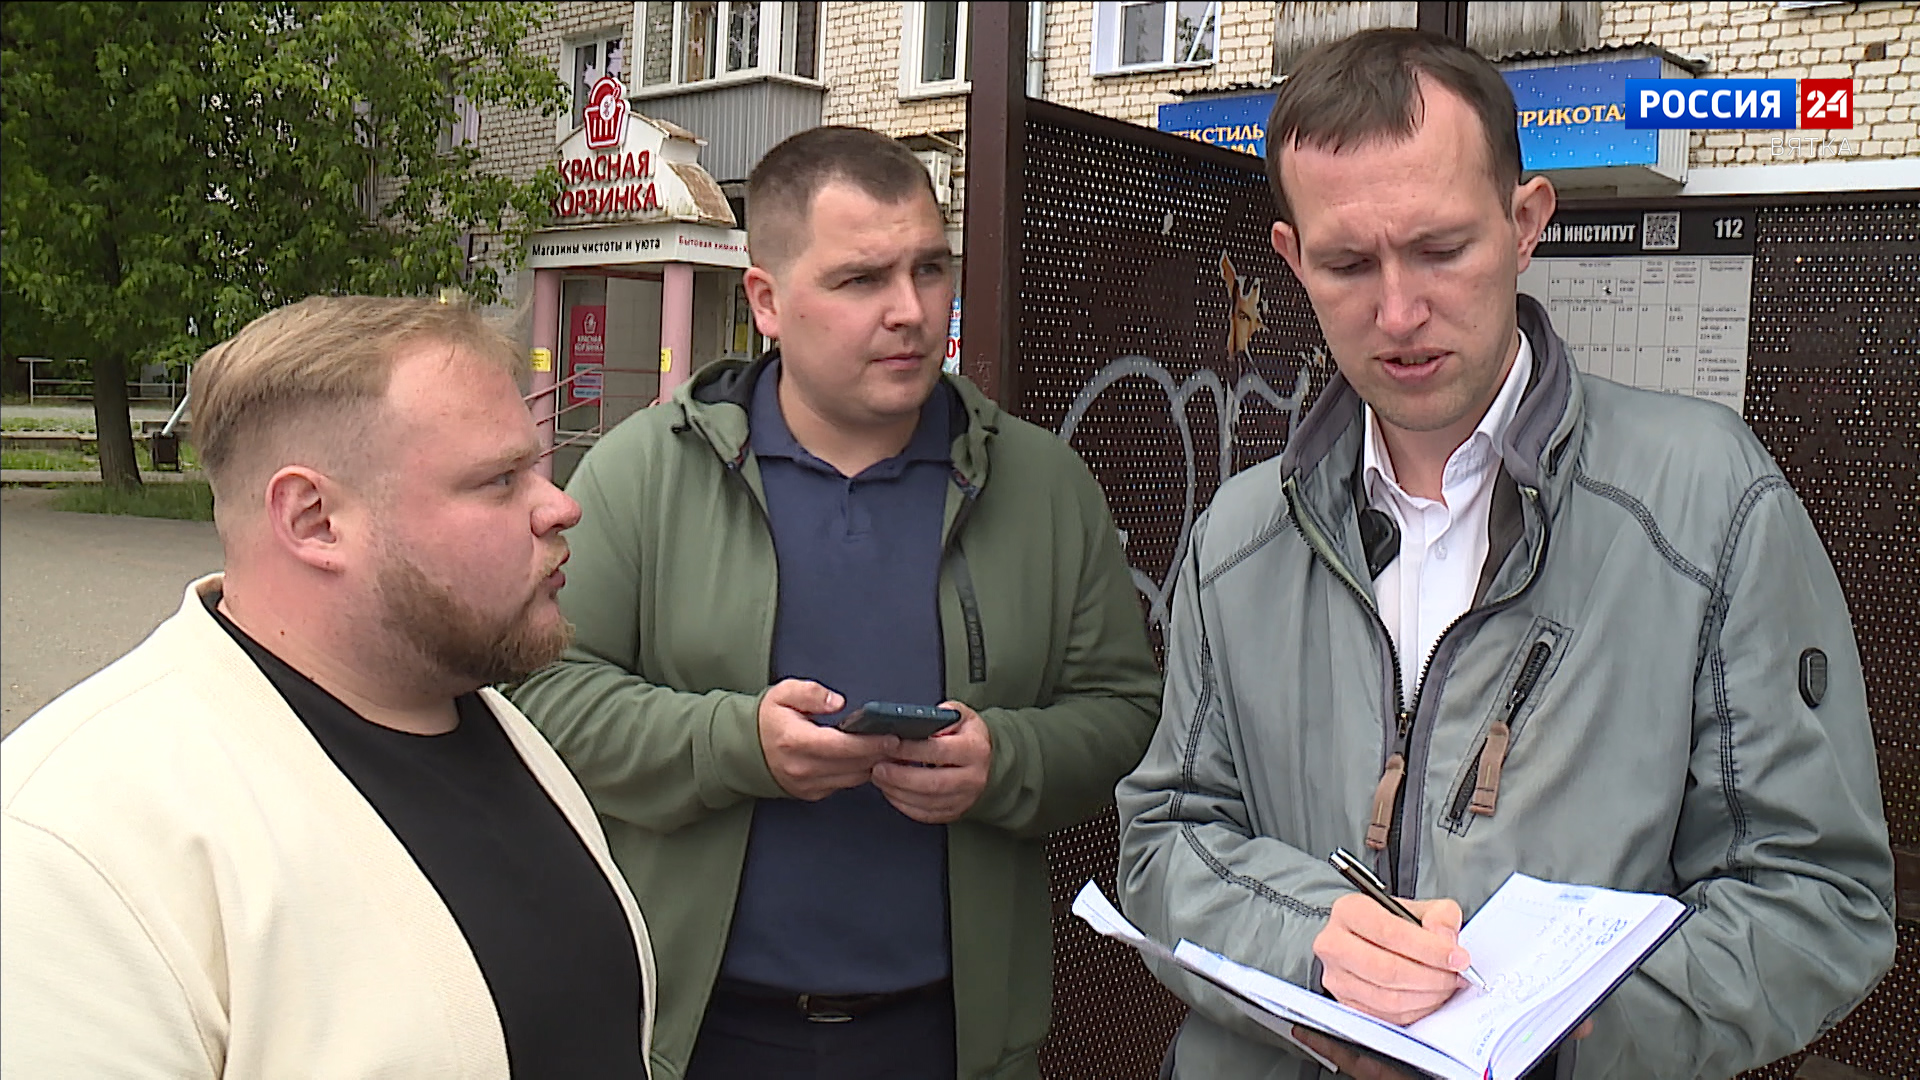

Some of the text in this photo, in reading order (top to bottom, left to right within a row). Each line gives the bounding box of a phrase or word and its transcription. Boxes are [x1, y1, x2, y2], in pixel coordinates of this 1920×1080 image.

[1518, 103, 1626, 128] РИКОТА
[559, 150, 649, 185] КРАСНАЯ
[1564, 224, 1636, 242] ИНСТИТУТ
[1714, 218, 1744, 239] 112
[532, 238, 660, 256] Магазины чистоты и уюта
[679, 235, 711, 248] Бытовая
